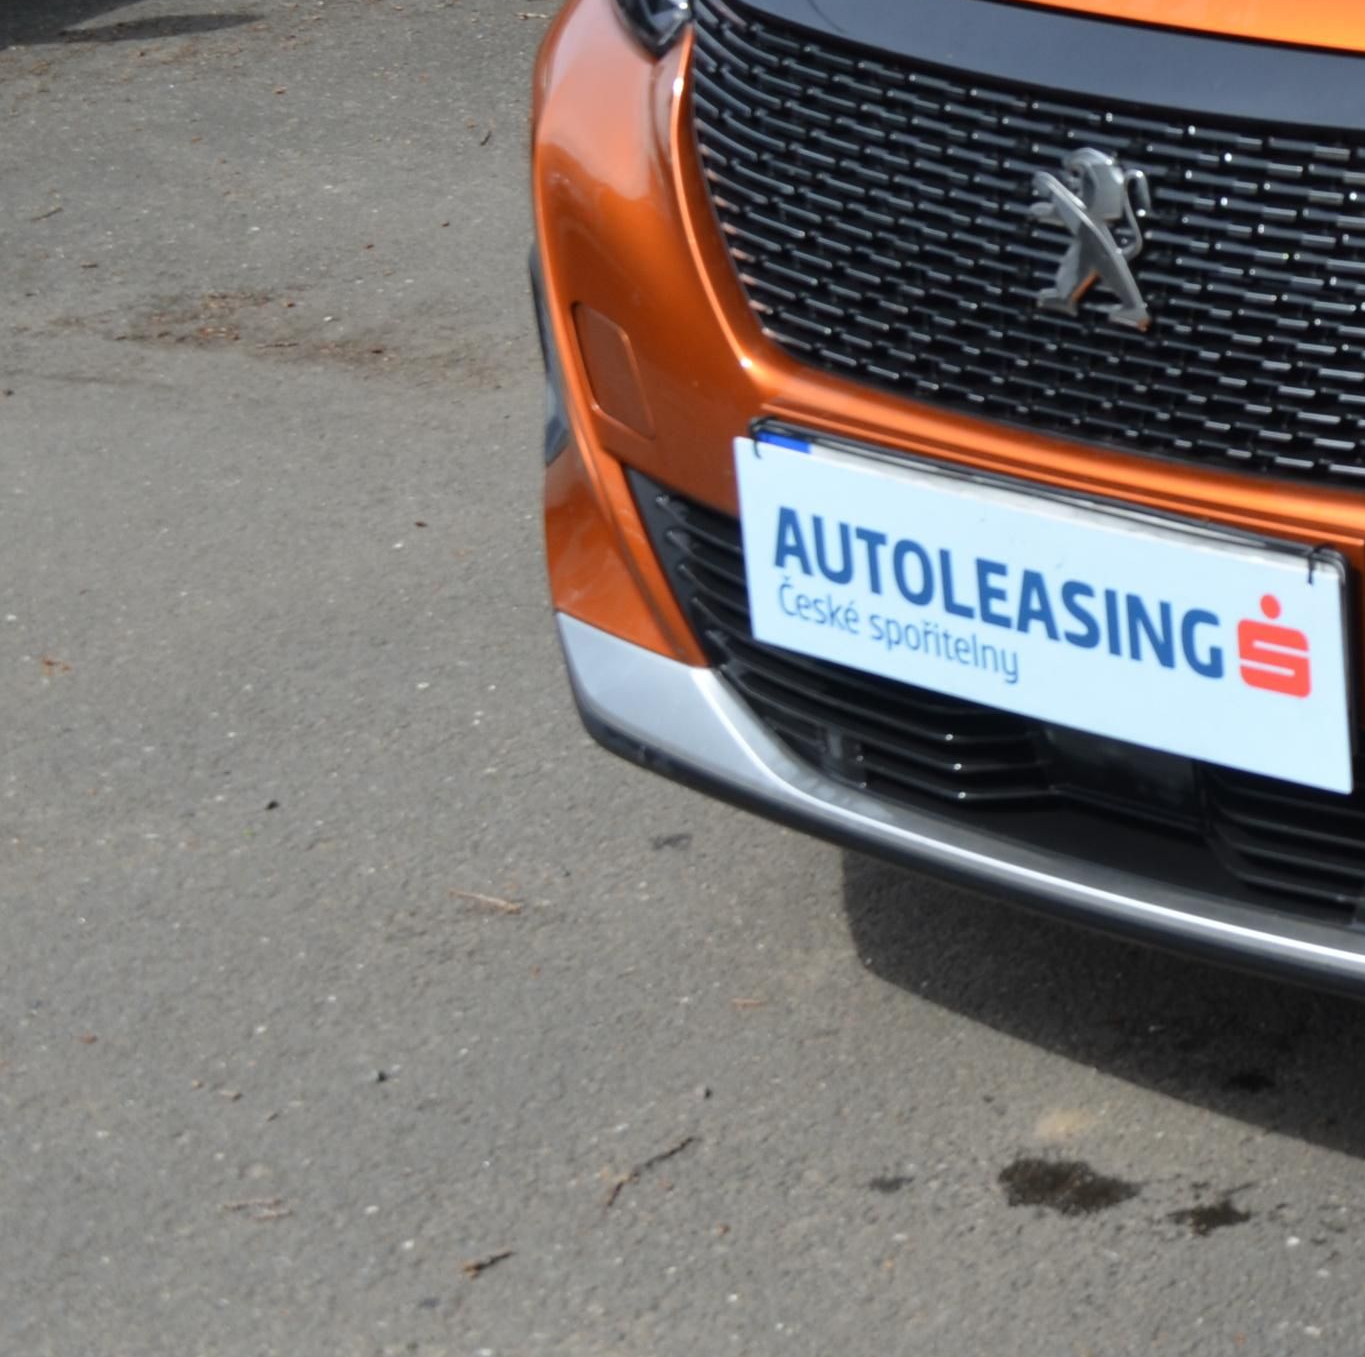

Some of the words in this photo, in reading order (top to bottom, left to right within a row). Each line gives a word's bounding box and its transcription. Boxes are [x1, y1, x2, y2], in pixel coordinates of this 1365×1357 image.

[773, 506, 1224, 680] AUTOLEASING
[777, 575, 861, 635] České
[868, 610, 1020, 685] spořitelny
